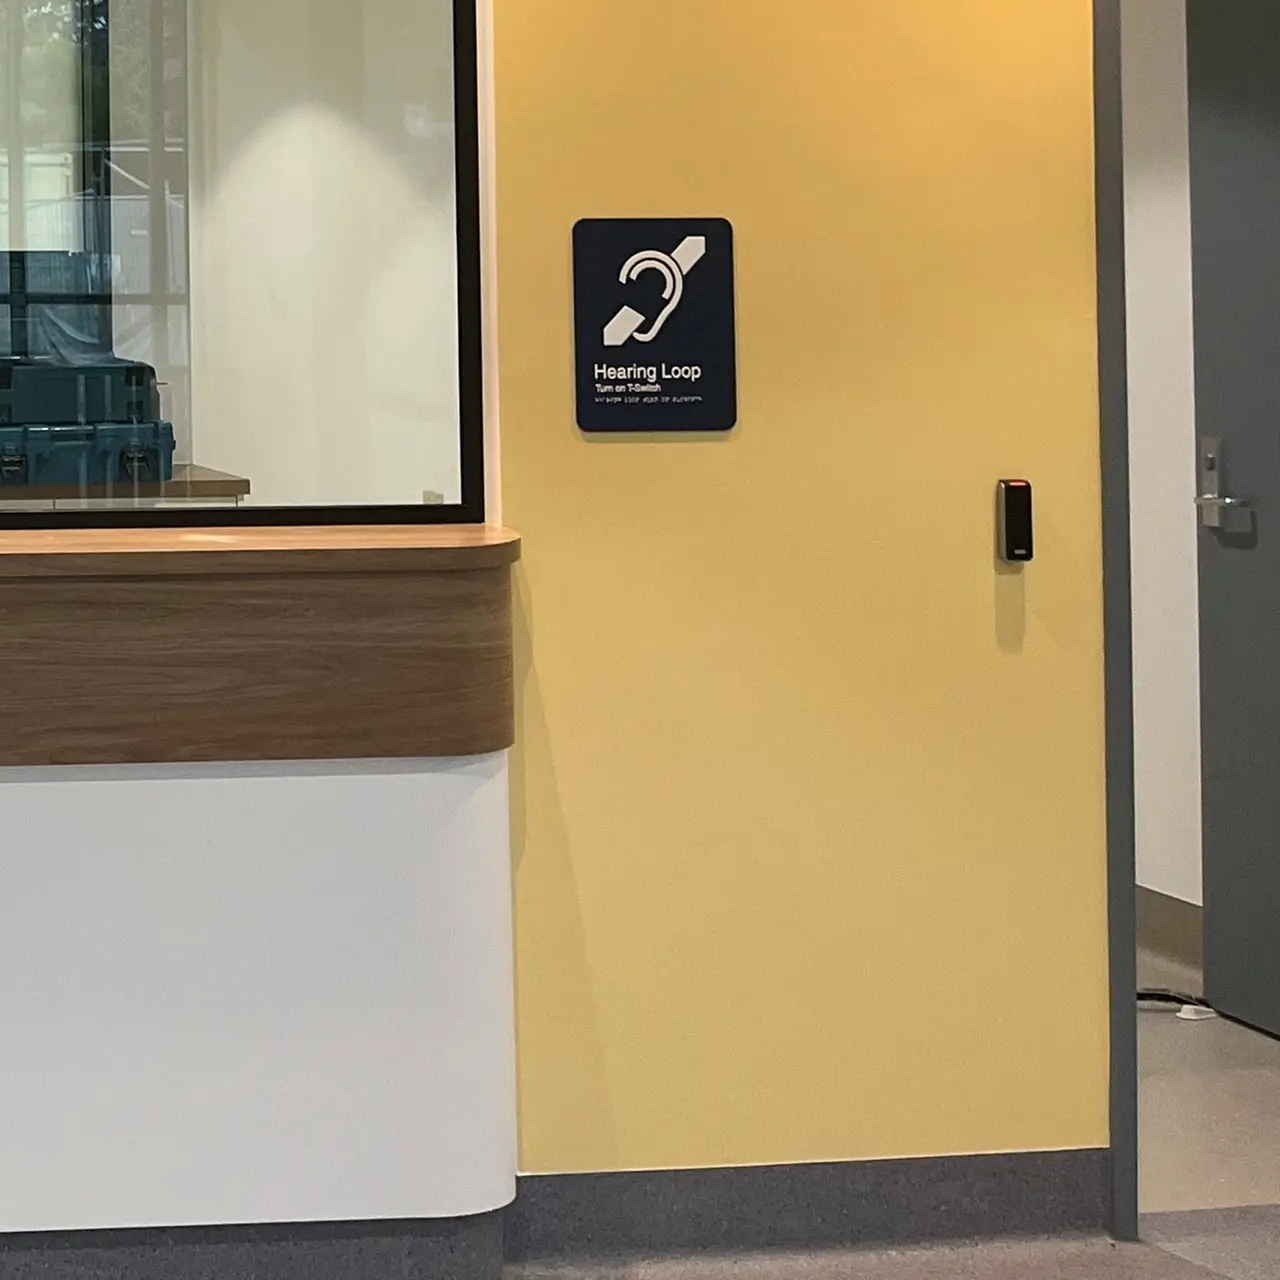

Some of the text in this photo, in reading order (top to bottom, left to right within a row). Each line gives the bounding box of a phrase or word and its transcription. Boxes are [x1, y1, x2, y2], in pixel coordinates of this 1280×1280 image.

[594, 363, 702, 382] Hearing Loop
[595, 383, 661, 393] Turn on T-Switch
